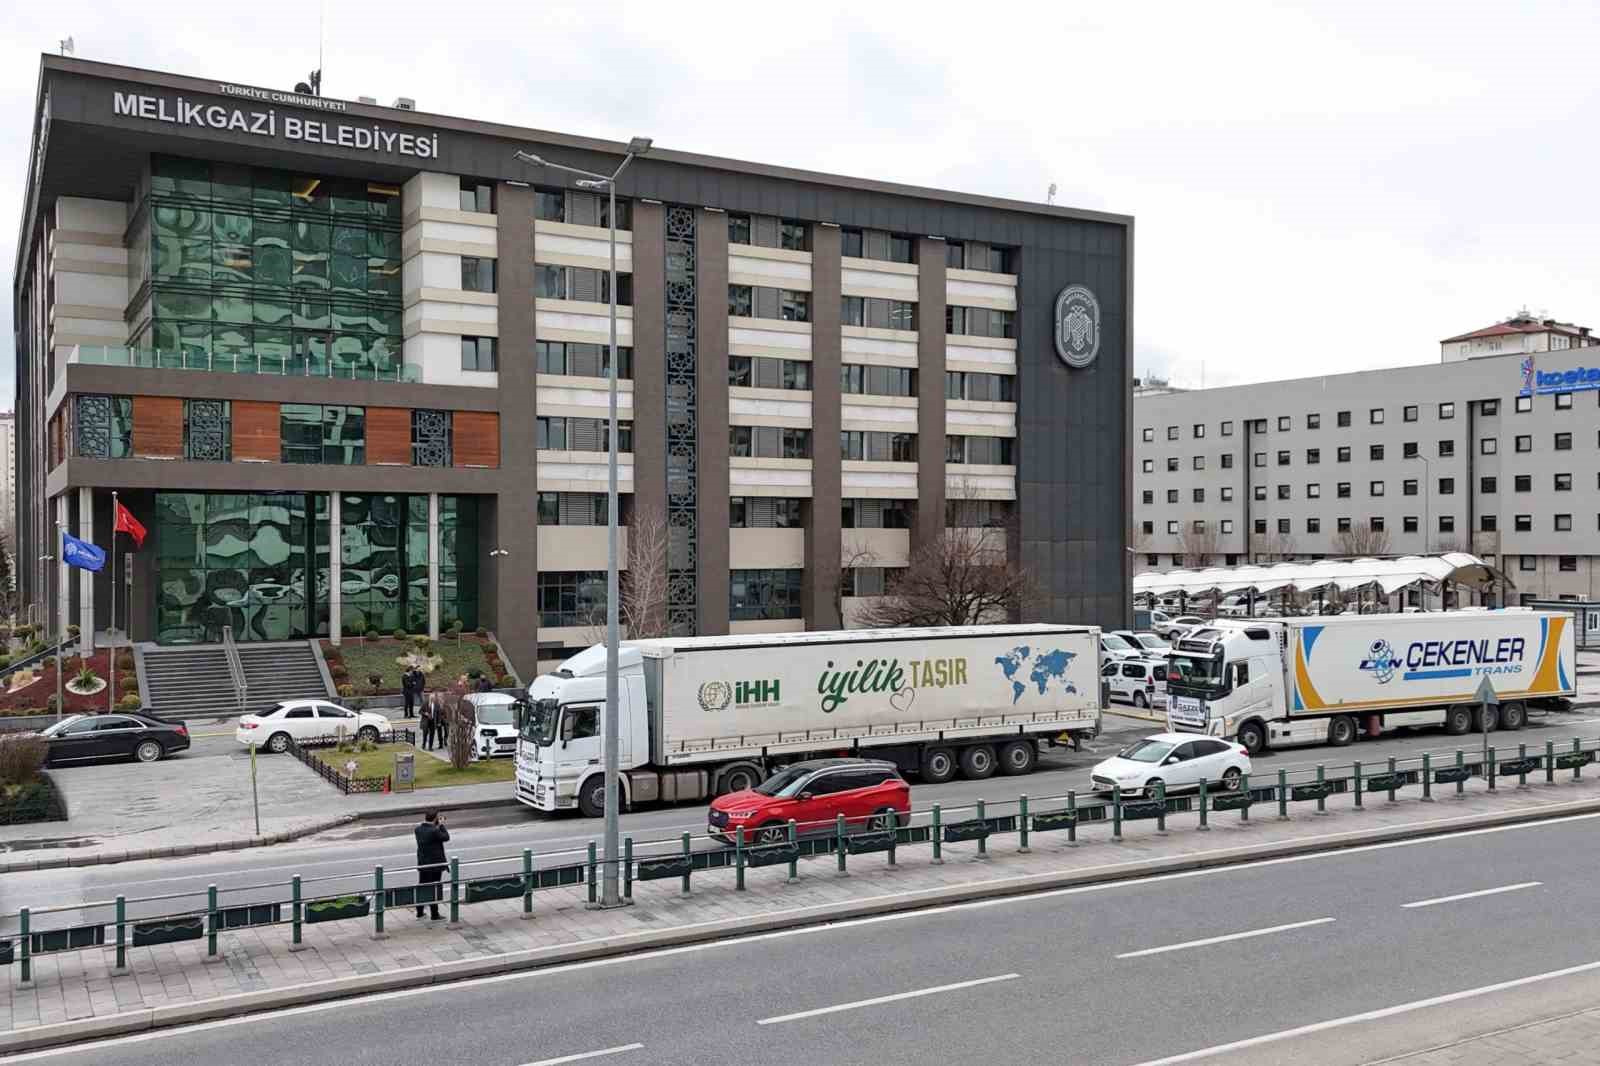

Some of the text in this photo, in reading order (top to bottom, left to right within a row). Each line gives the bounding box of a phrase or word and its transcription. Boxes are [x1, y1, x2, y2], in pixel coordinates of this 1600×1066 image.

[220, 84, 347, 111] TÜRKİYE CUMHURİYETİ
[113, 91, 438, 158] MELİKGAZİ BELEDİYESİ
[1406, 638, 1525, 672] ÇEKENLER
[1474, 664, 1523, 676] TRANS
[817, 658, 968, 713] iyilik TAŞIR
